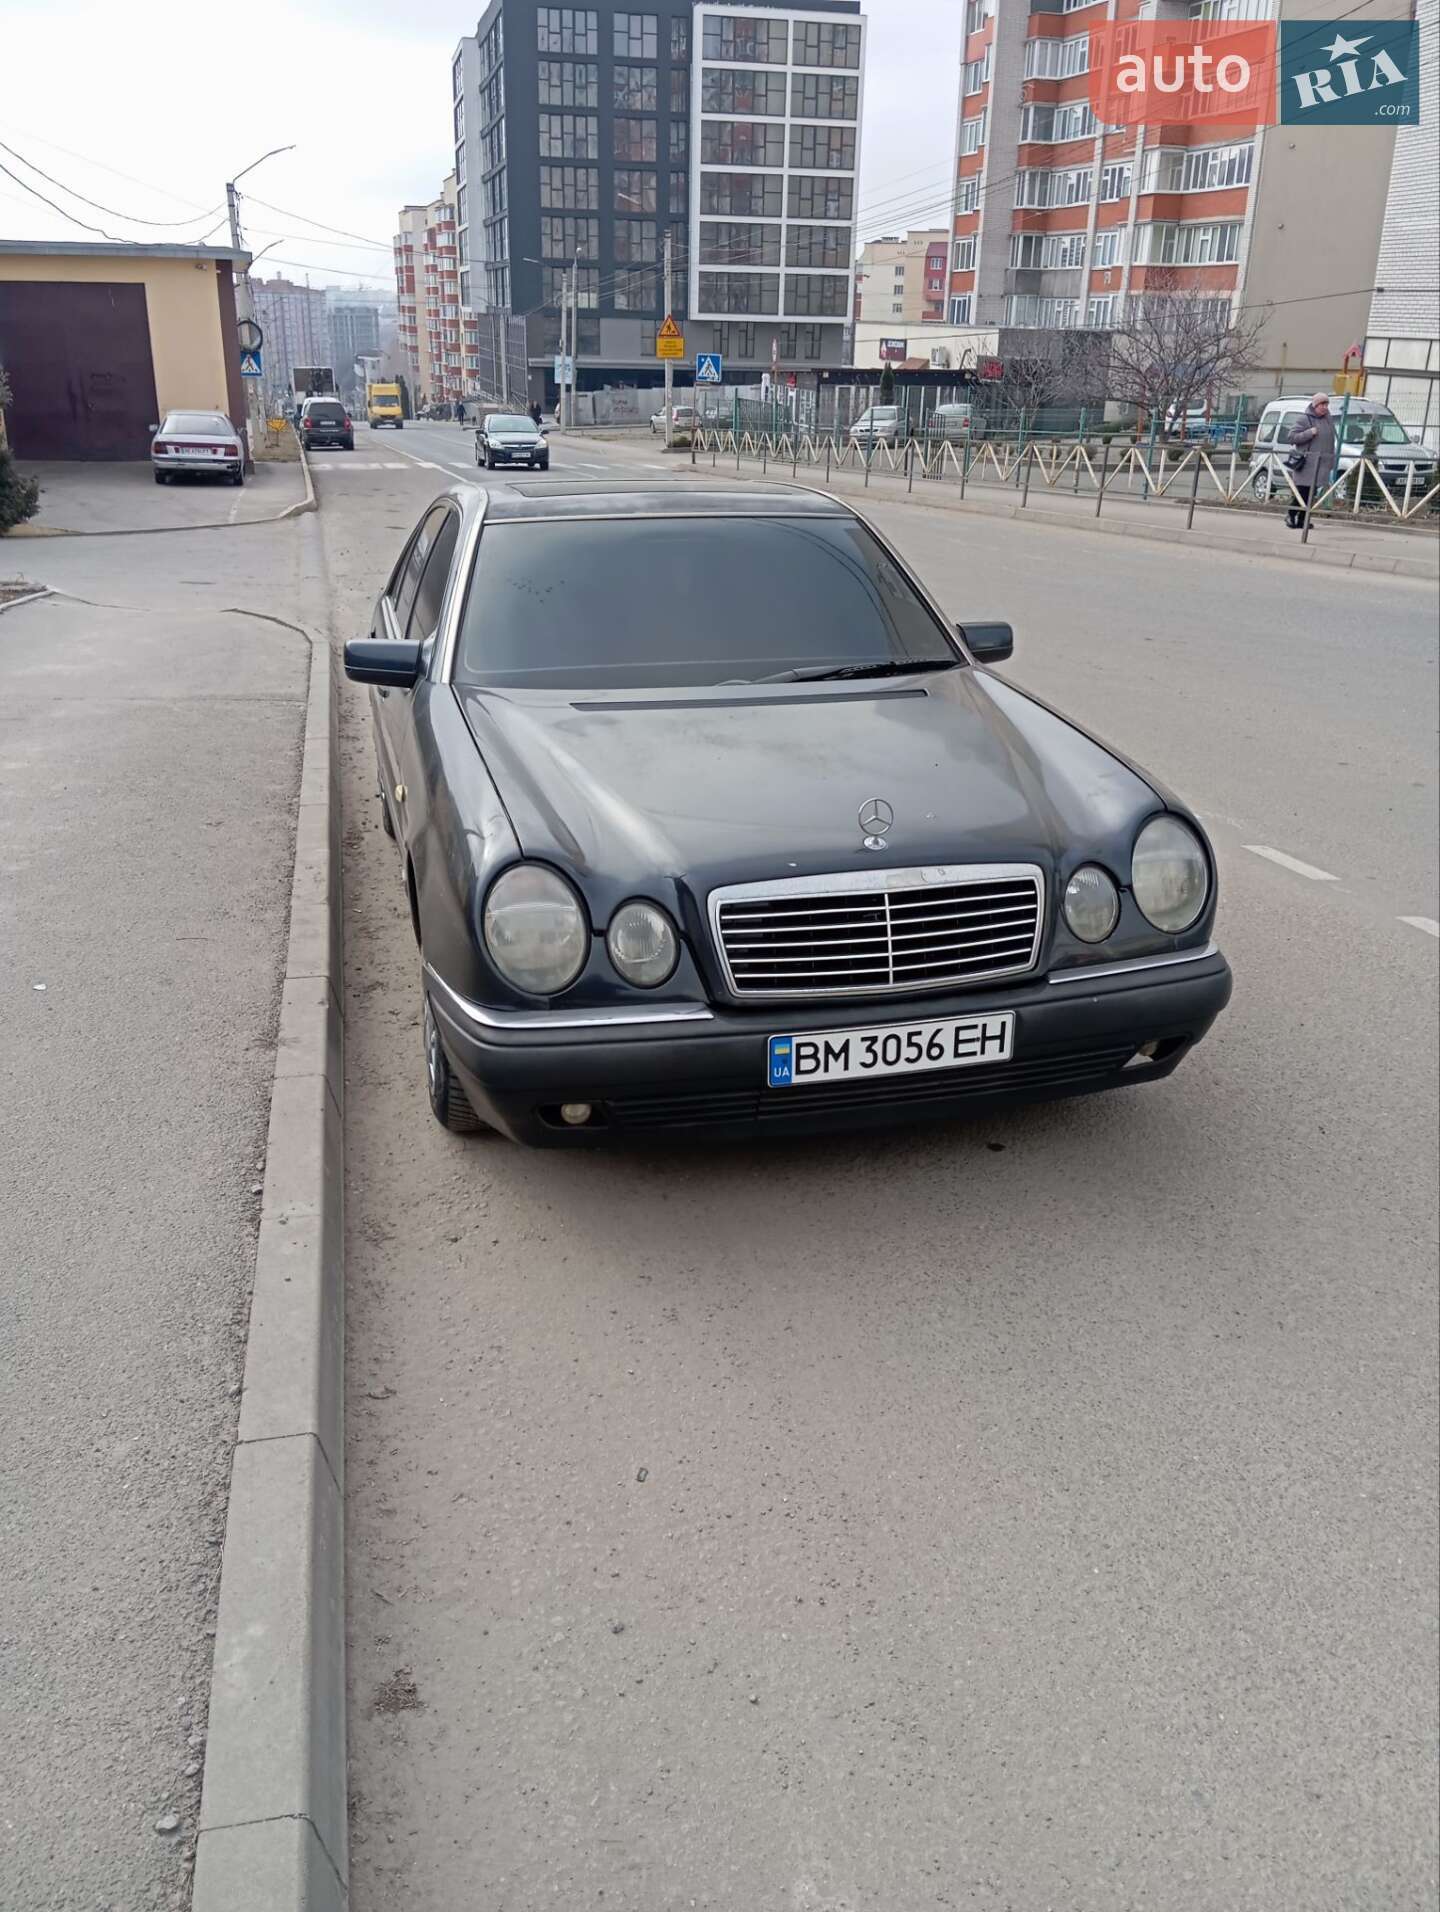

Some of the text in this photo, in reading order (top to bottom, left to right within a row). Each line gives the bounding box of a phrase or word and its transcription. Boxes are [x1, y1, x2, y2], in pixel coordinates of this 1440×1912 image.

[794, 1020, 1007, 1076] BM 3056 EH
[774, 1067, 790, 1079] UA
